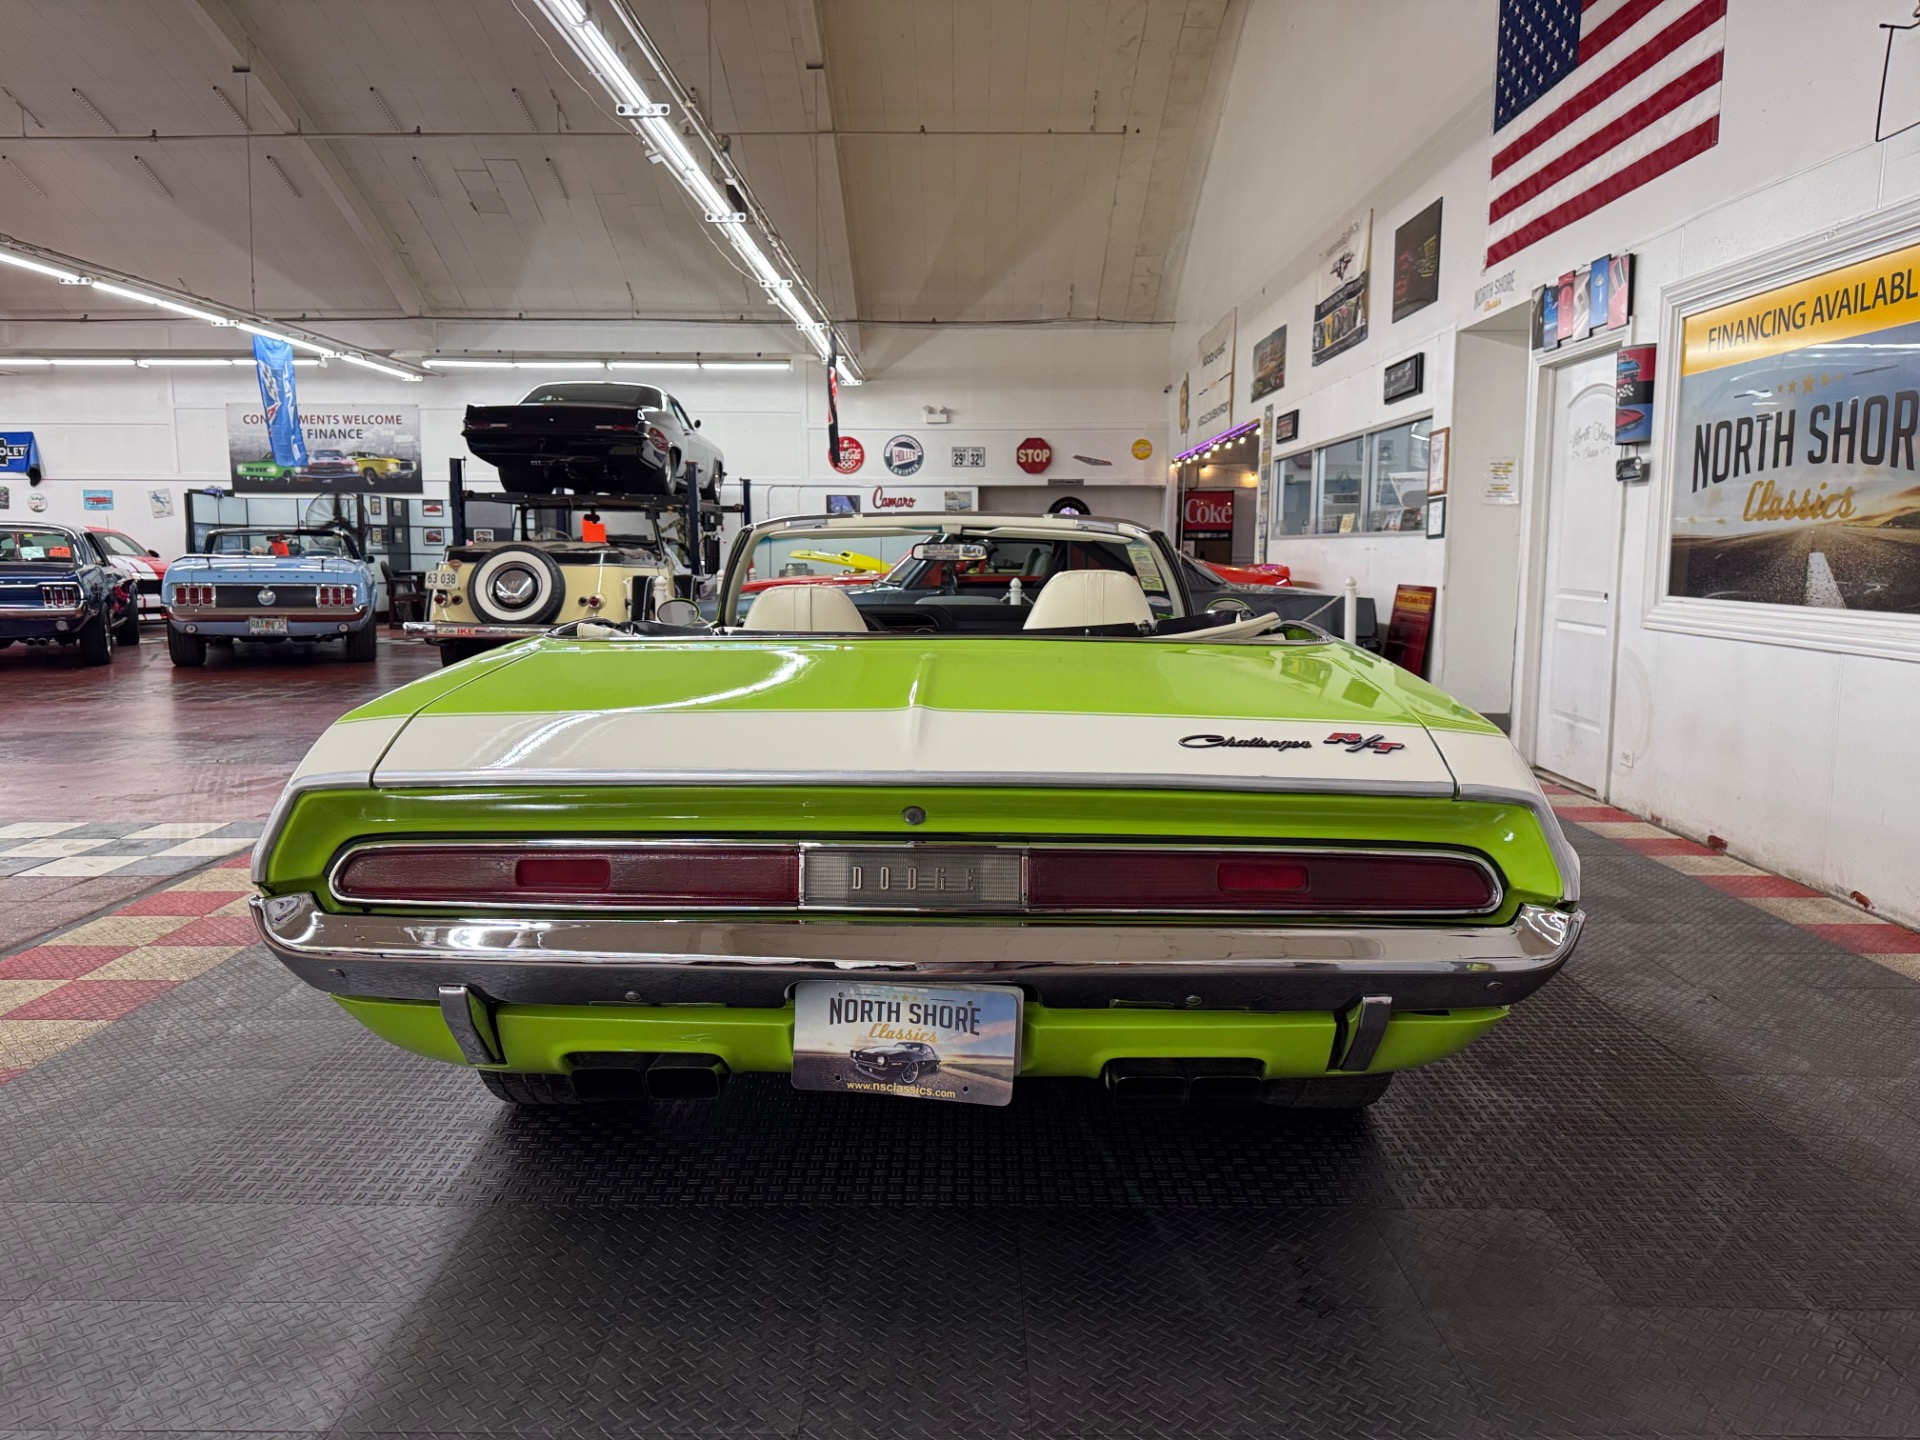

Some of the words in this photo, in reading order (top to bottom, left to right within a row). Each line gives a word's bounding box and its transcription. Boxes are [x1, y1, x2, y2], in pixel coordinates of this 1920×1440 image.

[1708, 300, 1806, 353] FINANCING
[1810, 268, 1918, 326] AVAILABL
[342, 414, 402, 425] WELCOME
[307, 428, 364, 439] FINANCE
[1692, 409, 1796, 493] NORTH
[1808, 390, 1920, 471] SHOR
[894, 448, 917, 464] HOLLEY
[1018, 449, 1050, 463] STOP
[872, 485, 917, 509] Camaro
[1743, 479, 1857, 522] Classics
[1185, 498, 1233, 524] Coke
[427, 573, 438, 583] 63
[440, 573, 456, 584] 038
[1178, 734, 1312, 752] Challenger
[1323, 732, 1404, 754] R/T
[851, 866, 975, 891] DODGE
[829, 997, 900, 1025] NORTH
[908, 1003, 981, 1036] SHORE
[868, 1023, 938, 1043] Classics
[847, 1080, 956, 1098] www.nsclassics.com
